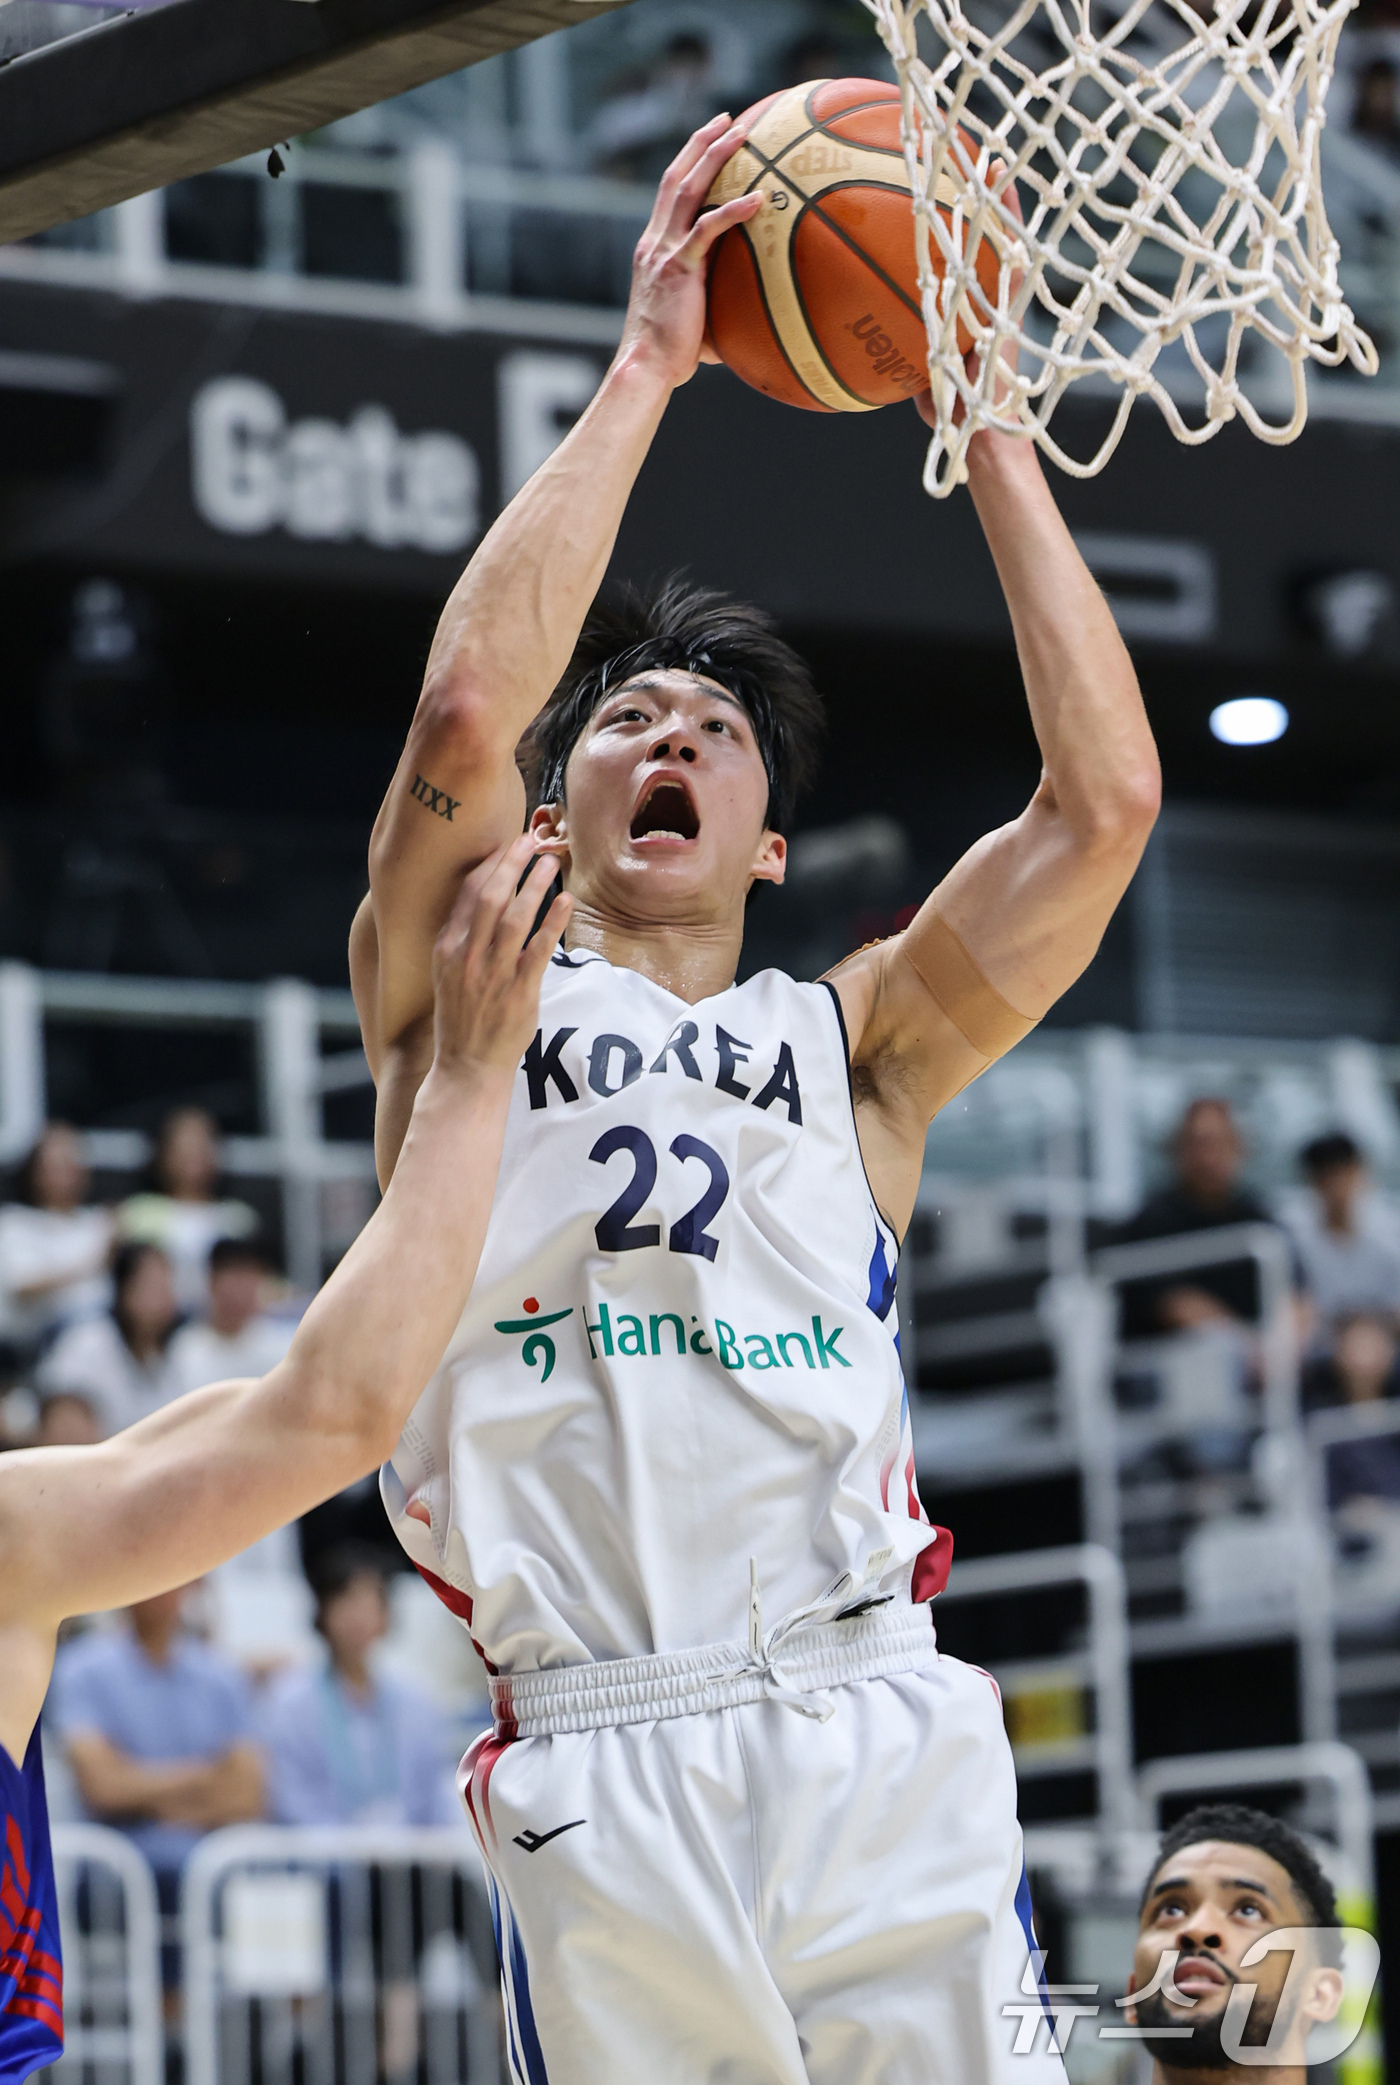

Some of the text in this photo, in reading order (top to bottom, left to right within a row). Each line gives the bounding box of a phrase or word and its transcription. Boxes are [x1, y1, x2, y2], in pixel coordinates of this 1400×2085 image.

[852, 312, 931, 394] molten
[192, 375, 480, 555] Gate
[520, 1019, 804, 1127] KOREA
[588, 1124, 730, 1264] 22
[715, 1315, 854, 1370] Bank
